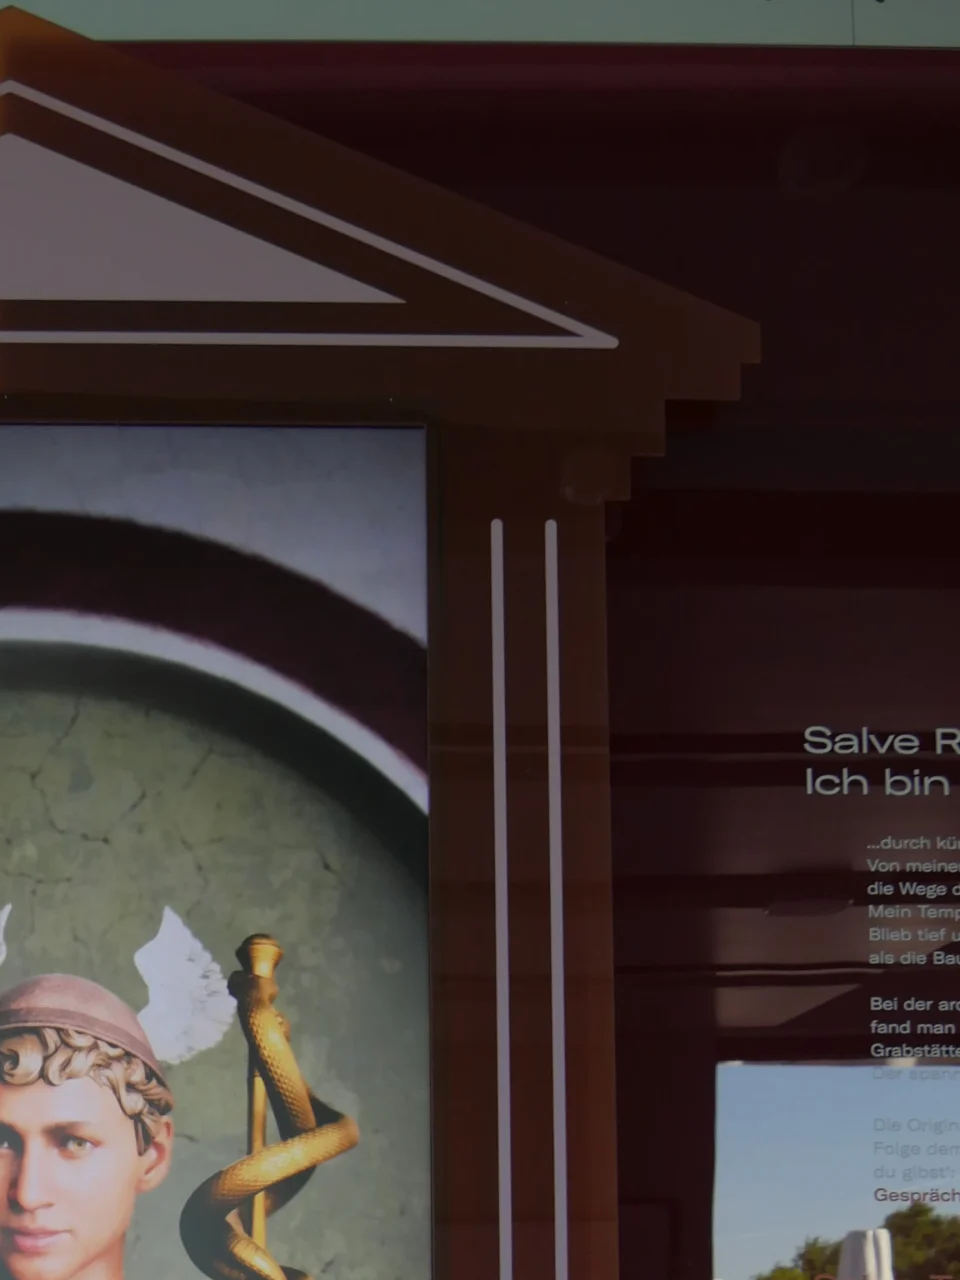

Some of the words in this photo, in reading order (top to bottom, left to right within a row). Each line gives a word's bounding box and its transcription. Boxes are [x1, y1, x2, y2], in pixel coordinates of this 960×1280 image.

[803, 726, 920, 754] Salve
[806, 767, 869, 795] Ich
[885, 768, 950, 796] bin
[867, 836, 931, 850] ...durch
[936, 836, 960, 850] kü
[866, 859, 900, 873] Von
[906, 860, 960, 873] meine
[867, 881, 895, 896] die
[898, 882, 948, 899] Wege
[868, 905, 911, 918] Mein
[869, 927, 911, 941] Blieb
[917, 929, 947, 941] tief
[869, 951, 895, 964] als
[900, 951, 927, 964] die
[870, 996, 898, 1010] Bei
[903, 997, 933, 1010] der
[870, 1020, 911, 1034] fand
[917, 1023, 956, 1034] man
[874, 1118, 902, 1131] Die
[907, 1118, 960, 1134] Origin
[874, 1142, 920, 1158] Folge
[874, 1165, 896, 1178] du
[874, 1187, 960, 1204] Gespräch
